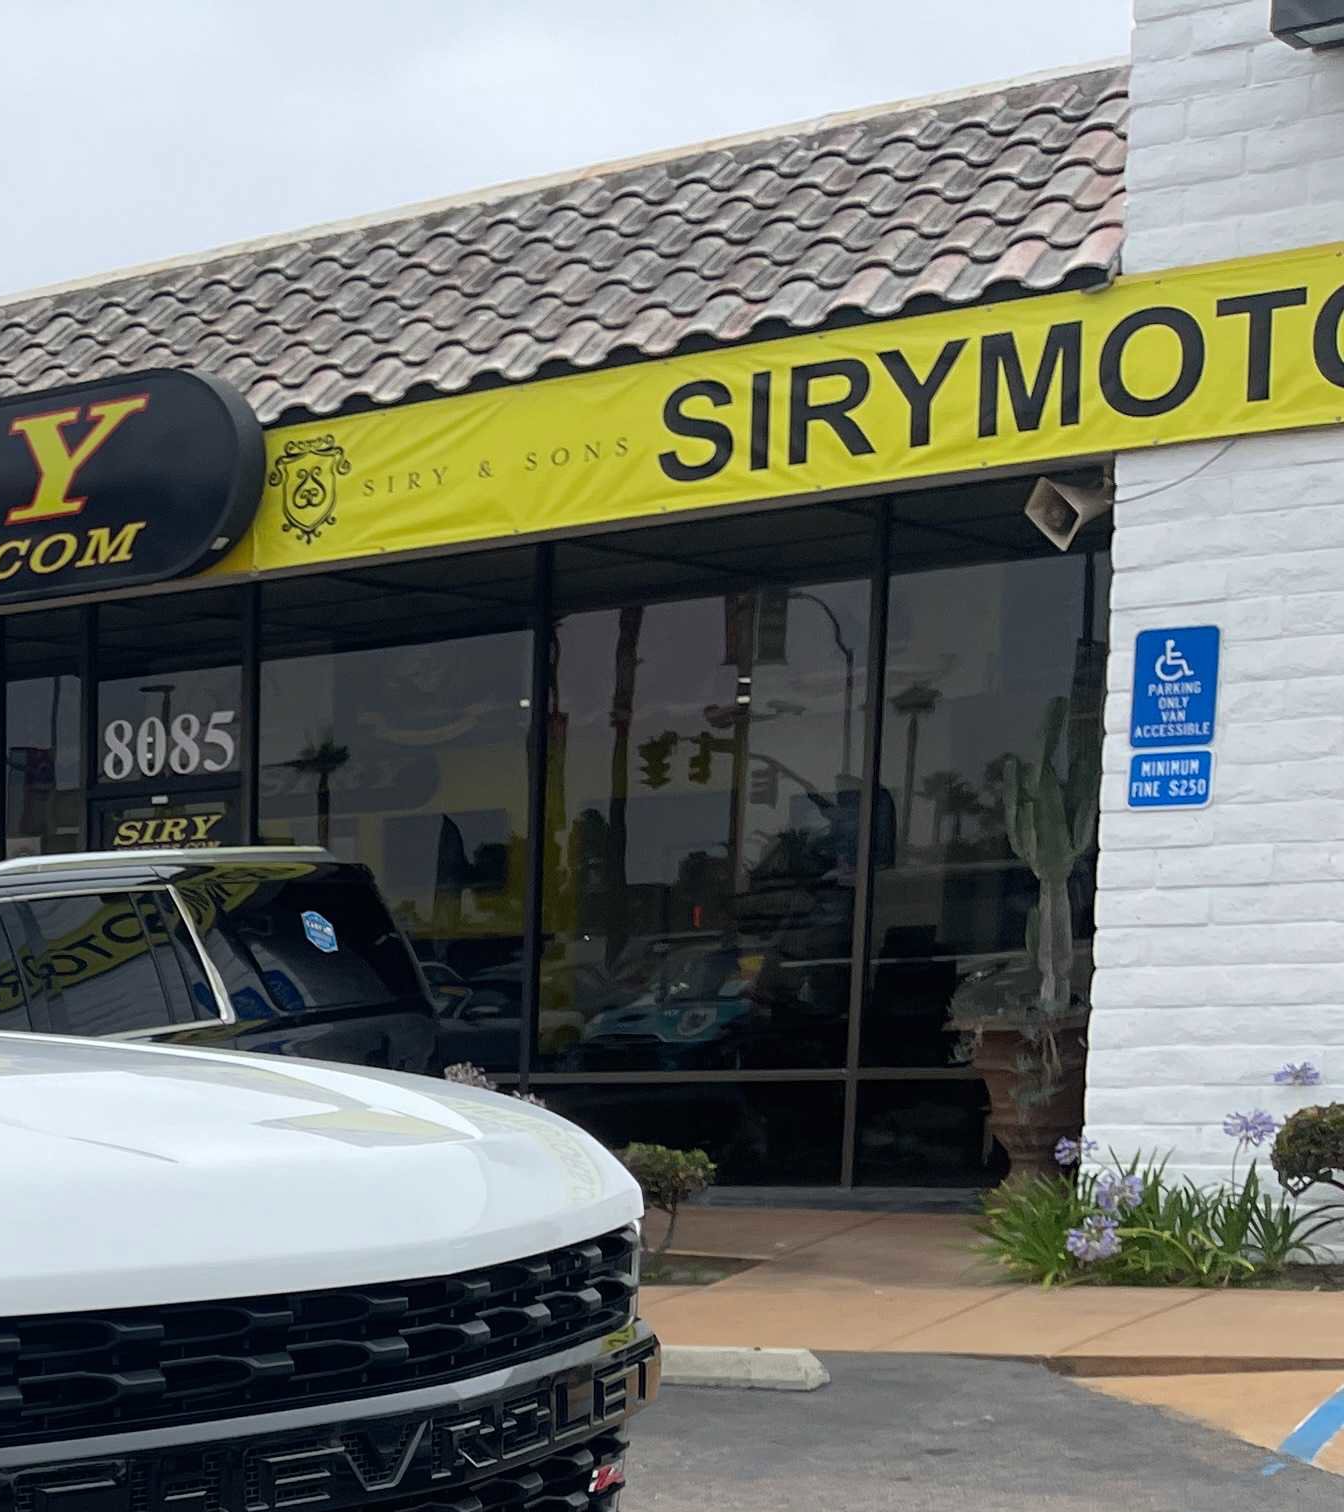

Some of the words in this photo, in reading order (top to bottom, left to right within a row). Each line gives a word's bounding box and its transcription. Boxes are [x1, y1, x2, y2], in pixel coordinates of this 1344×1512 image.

[362, 466, 448, 497] SIRY
[478, 460, 494, 479] &
[524, 437, 630, 472] SONS
[1147, 681, 1202, 697] PARKING
[1157, 696, 1190, 710] ONLY
[1161, 710, 1186, 722] VAN
[1135, 721, 1211, 739] ACCESSIBLE
[103, 710, 236, 781] 8085
[1140, 759, 1200, 777] MINIMUM
[1131, 781, 1161, 798] FINE
[1168, 778, 1207, 798] $250
[113, 814, 223, 846] SIRY
